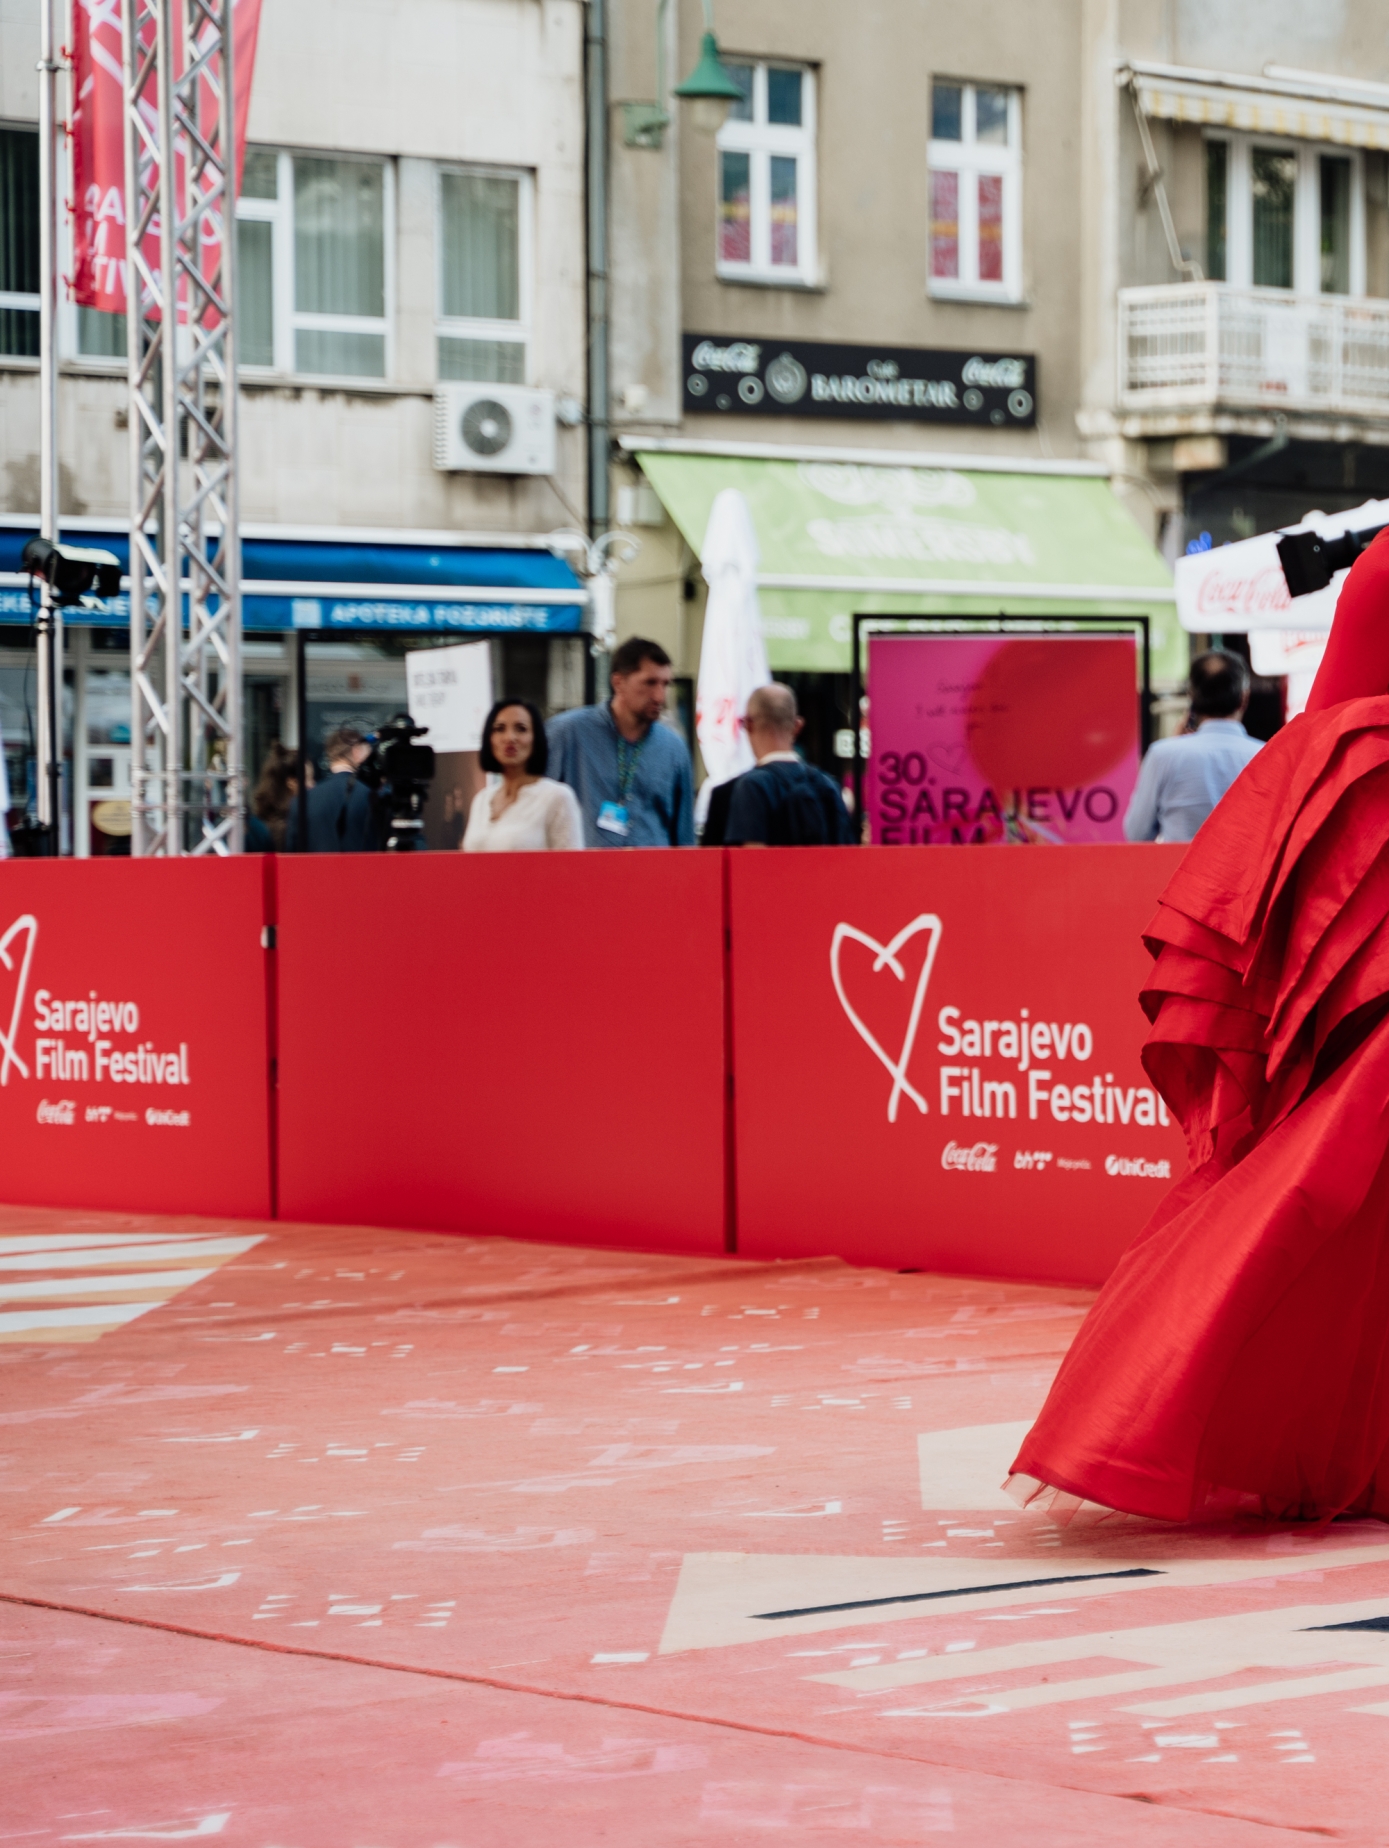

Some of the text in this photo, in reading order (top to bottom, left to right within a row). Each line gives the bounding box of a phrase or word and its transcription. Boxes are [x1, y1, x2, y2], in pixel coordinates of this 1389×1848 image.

[811, 373, 960, 408] BAROMETAR
[330, 602, 431, 625] APOTEKA
[877, 751, 938, 787] 30.
[879, 786, 1119, 824] SARAJEVO
[34, 989, 139, 1043] Sarajevo
[938, 1005, 1093, 1071] Sarajevo
[36, 1038, 190, 1085] Film Festival
[940, 1066, 1170, 1127] Film Festival
[1119, 1156, 1171, 1178] UniCredit
